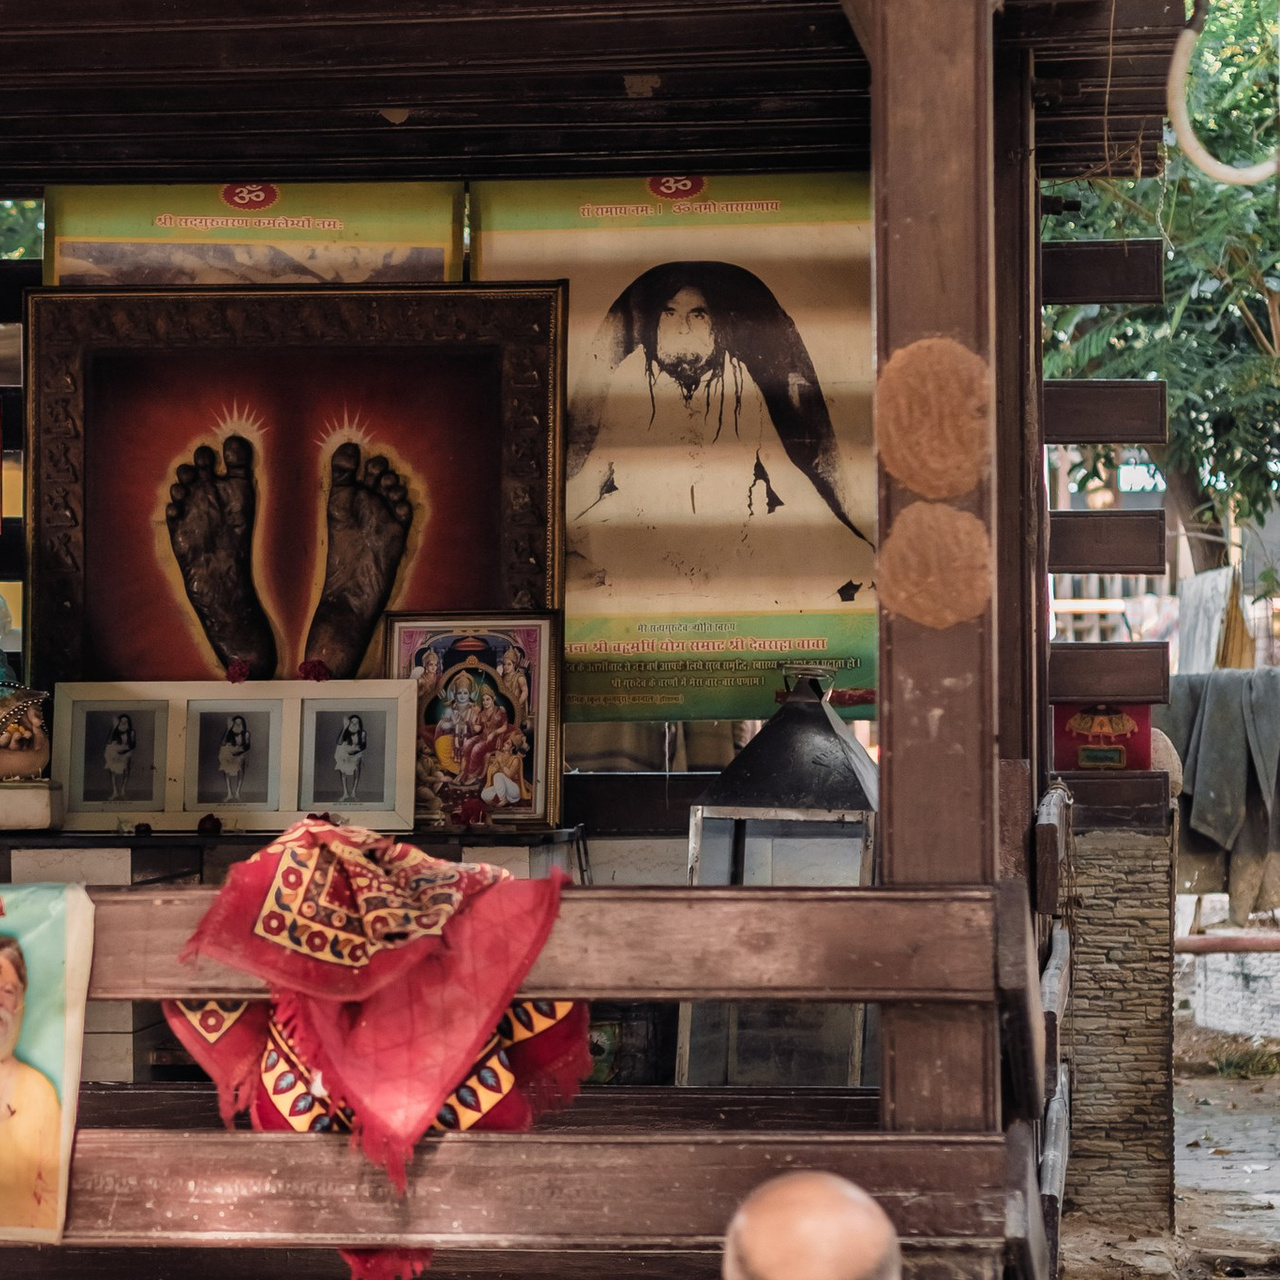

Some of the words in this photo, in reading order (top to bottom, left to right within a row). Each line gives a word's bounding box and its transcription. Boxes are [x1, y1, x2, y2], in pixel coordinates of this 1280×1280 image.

[157, 214, 173, 227] श्री
[593, 639, 608, 653] श्री
[729, 637, 745, 651] श्री
